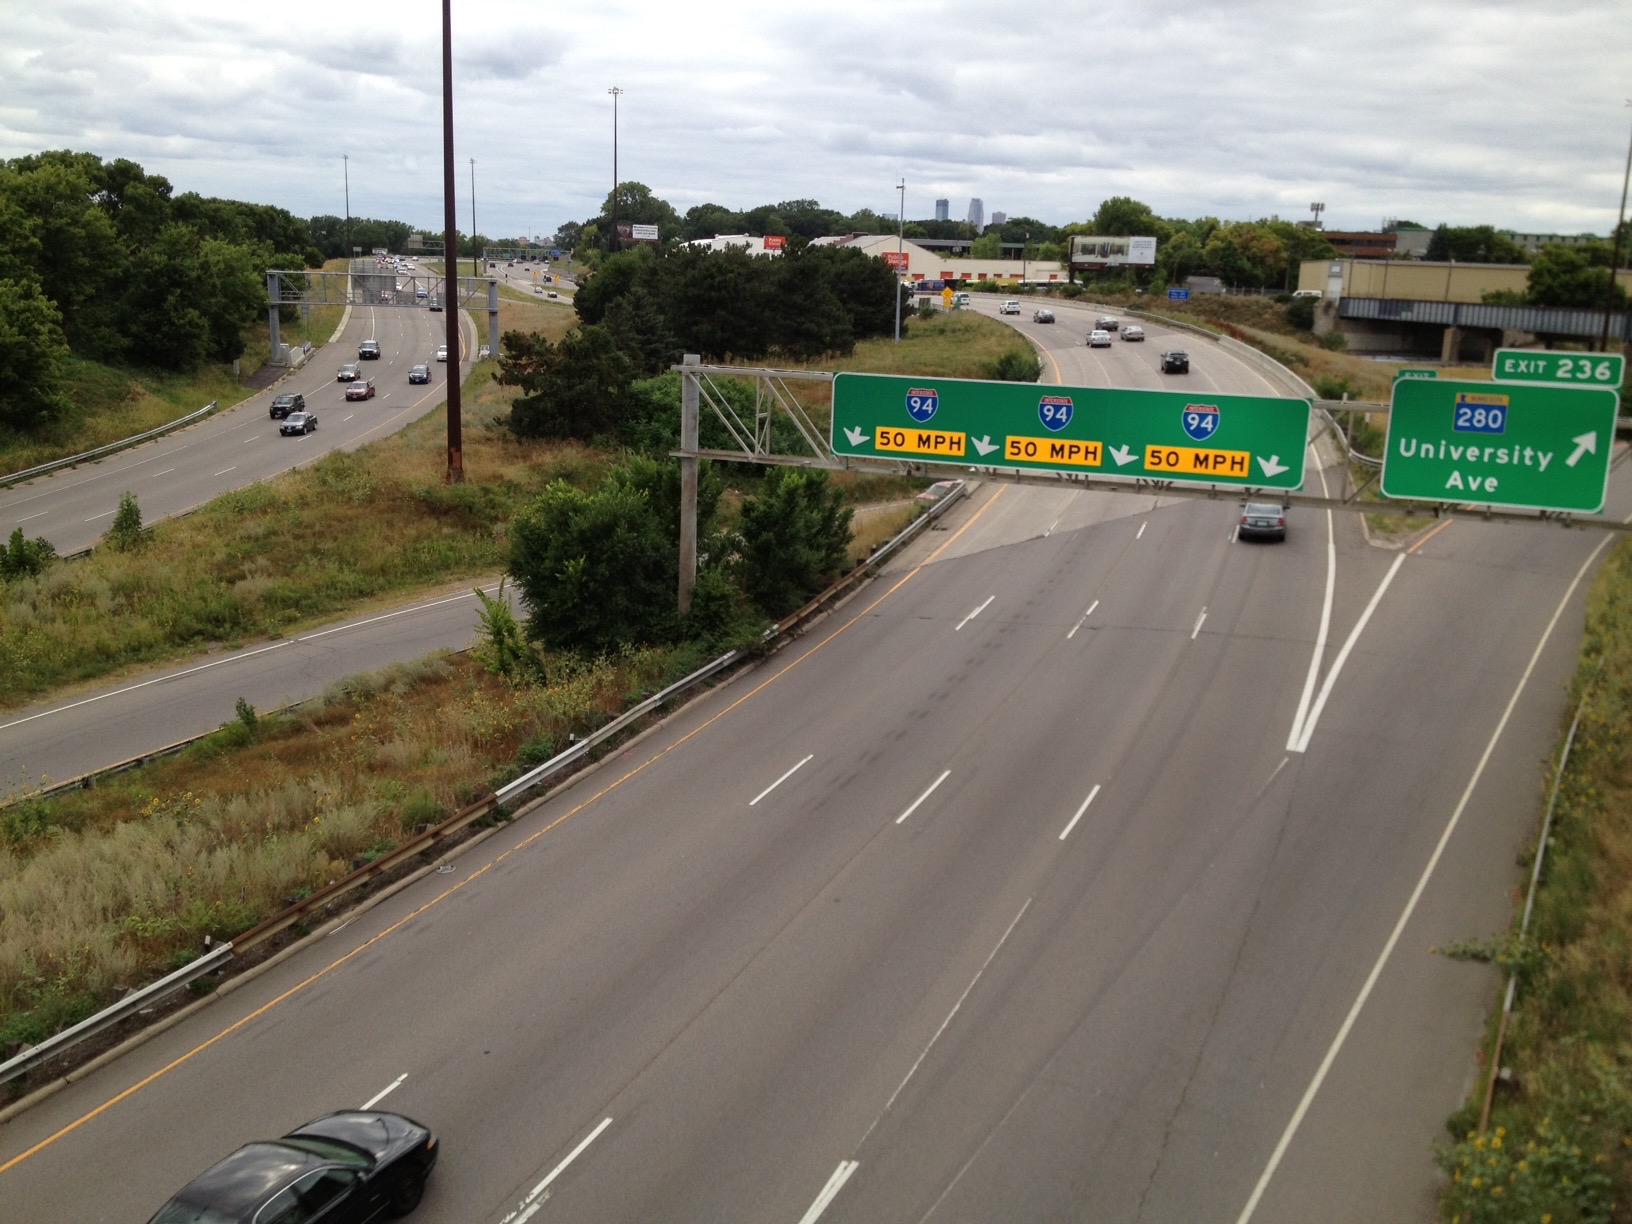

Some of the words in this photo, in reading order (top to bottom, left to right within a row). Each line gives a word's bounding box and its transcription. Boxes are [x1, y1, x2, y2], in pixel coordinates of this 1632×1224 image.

[1503, 358, 1548, 374] EXIT
[1555, 358, 1612, 381] 236
[910, 397, 933, 414] 94
[1043, 405, 1068, 423] 94
[1187, 413, 1213, 432] 94
[1457, 407, 1503, 429] 280
[879, 431, 905, 447] 50
[917, 433, 962, 451] MPH
[1010, 440, 1037, 457] 50
[1050, 443, 1098, 462] MPH
[1149, 450, 1179, 467] 50
[1193, 452, 1245, 472] MPH
[1399, 438, 1554, 473] University
[1444, 470, 1499, 493] Ave
